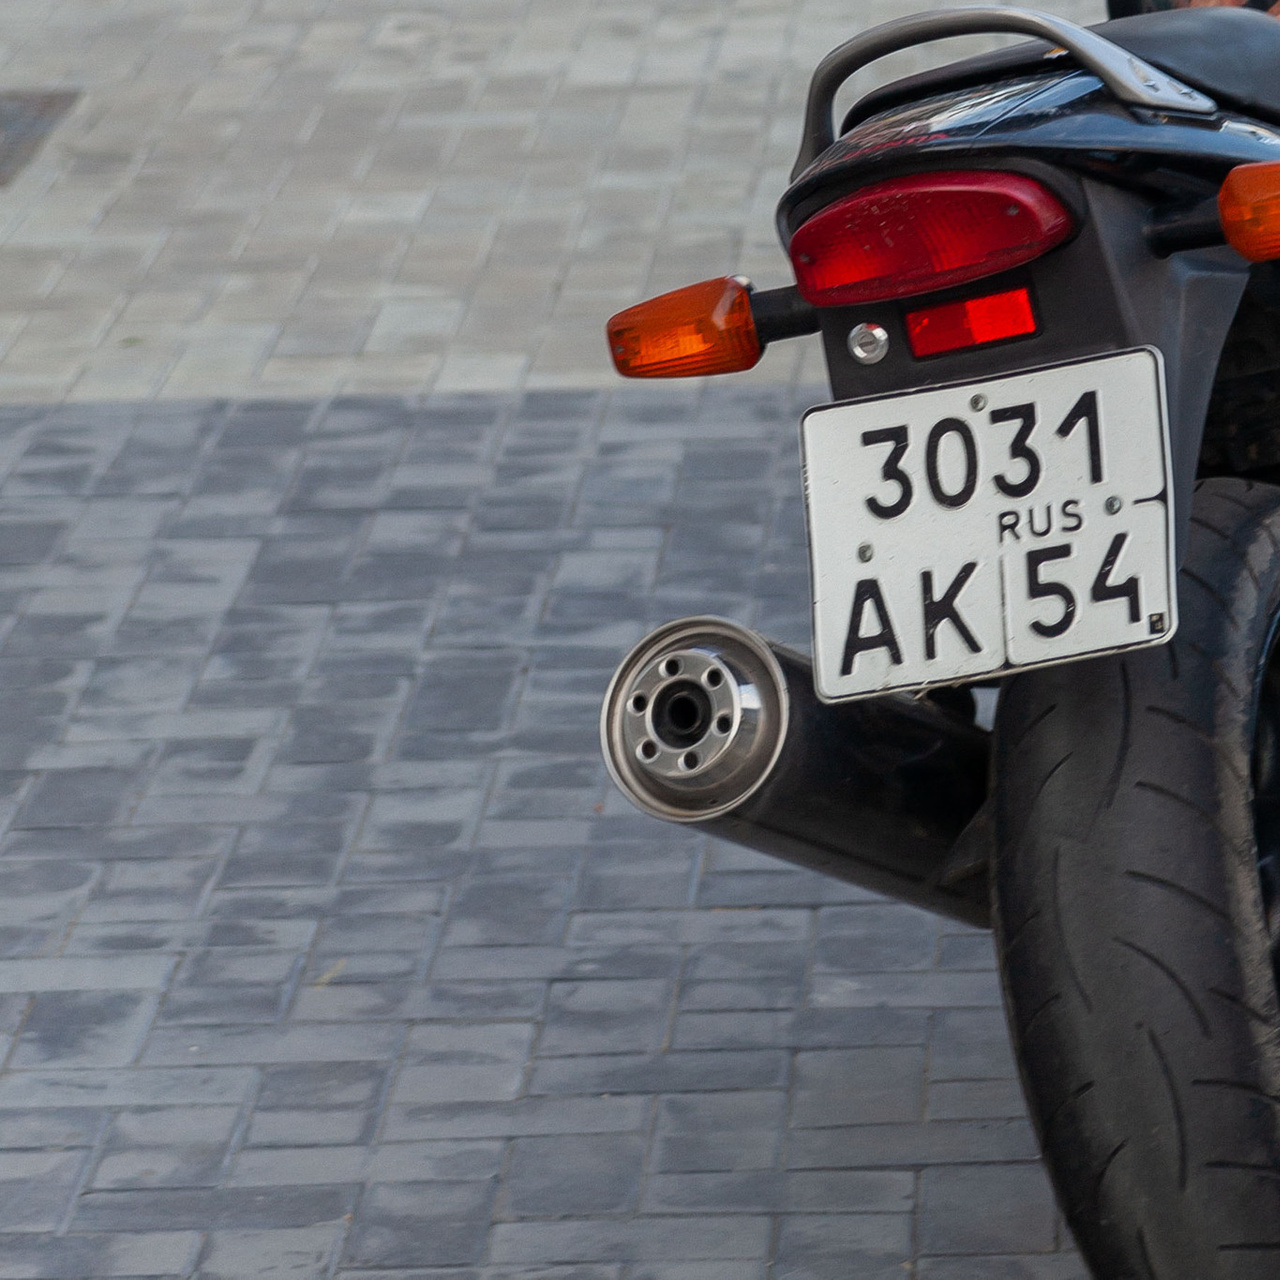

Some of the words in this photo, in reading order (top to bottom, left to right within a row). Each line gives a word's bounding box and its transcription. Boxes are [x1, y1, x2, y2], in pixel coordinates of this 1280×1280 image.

[861, 389, 1103, 520] 3031
[1000, 499, 1083, 541] RUS
[841, 561, 983, 676] AK
[1026, 532, 1142, 639] 54
